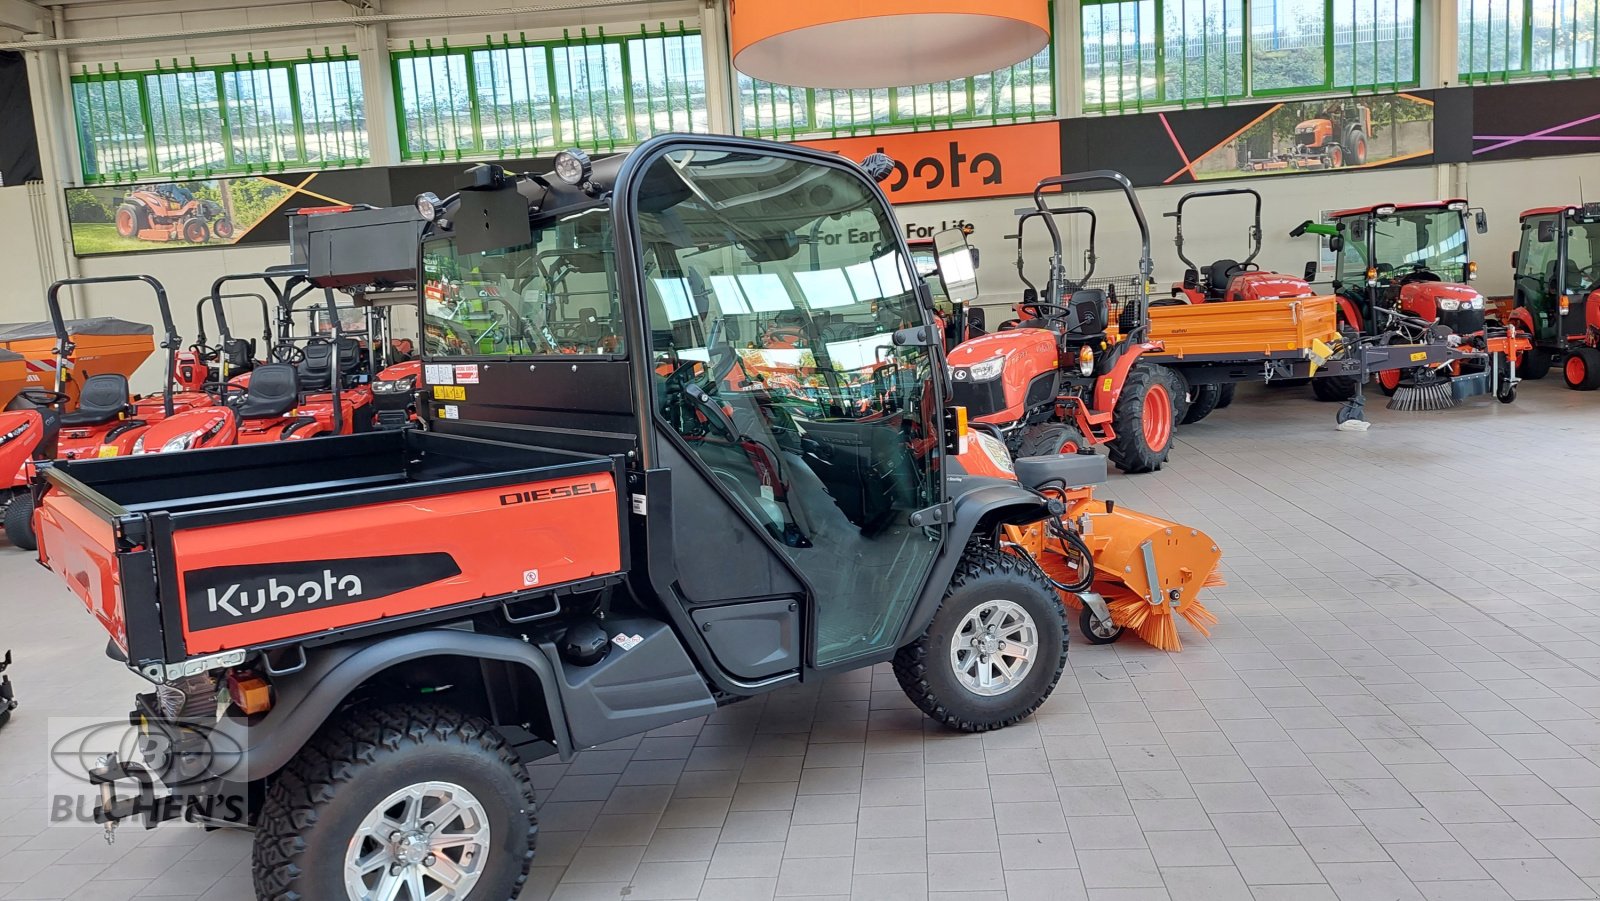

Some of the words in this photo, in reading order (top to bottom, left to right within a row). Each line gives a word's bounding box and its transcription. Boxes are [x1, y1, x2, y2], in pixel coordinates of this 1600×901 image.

[830, 142, 1002, 192] bota
[814, 230, 842, 246] For
[847, 228, 882, 244] Ear
[906, 223, 934, 238] For
[499, 482, 610, 506] DIESEL
[207, 569, 362, 617] Kubota
